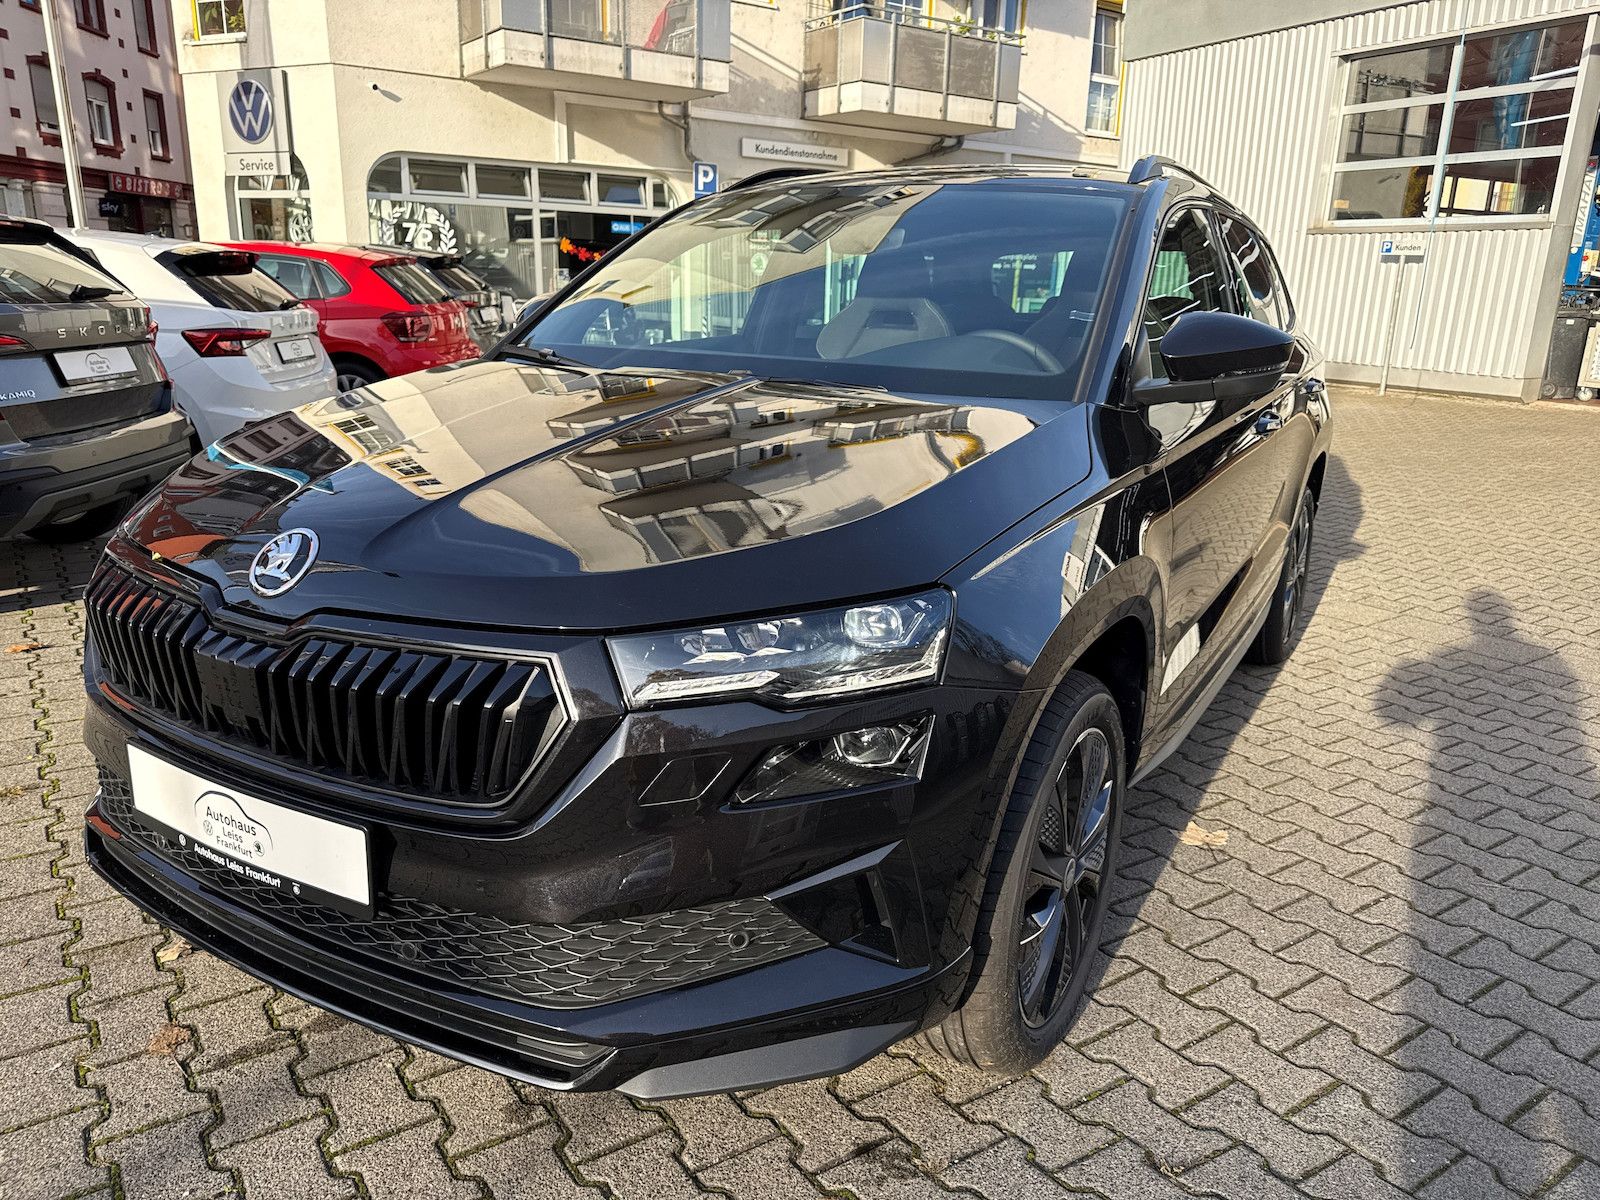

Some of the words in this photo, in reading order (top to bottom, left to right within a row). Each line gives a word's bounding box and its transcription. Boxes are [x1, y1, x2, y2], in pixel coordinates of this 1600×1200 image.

[755, 143, 838, 161] Kundendienstannahme
[239, 158, 274, 170] Service
[697, 164, 714, 191] P
[101, 202, 119, 213] sky
[1575, 177, 1593, 236] MAHA
[1395, 244, 1421, 252] Kunden
[0, 389, 36, 400] KAMIQ
[206, 806, 257, 836] Autohaus
[222, 827, 243, 843] Leiss
[216, 836, 253, 858] Frankfurt
[194, 843, 225, 866] Autohaus
[226, 858, 244, 874] Leiss
[245, 866, 281, 888] Frankfurt
